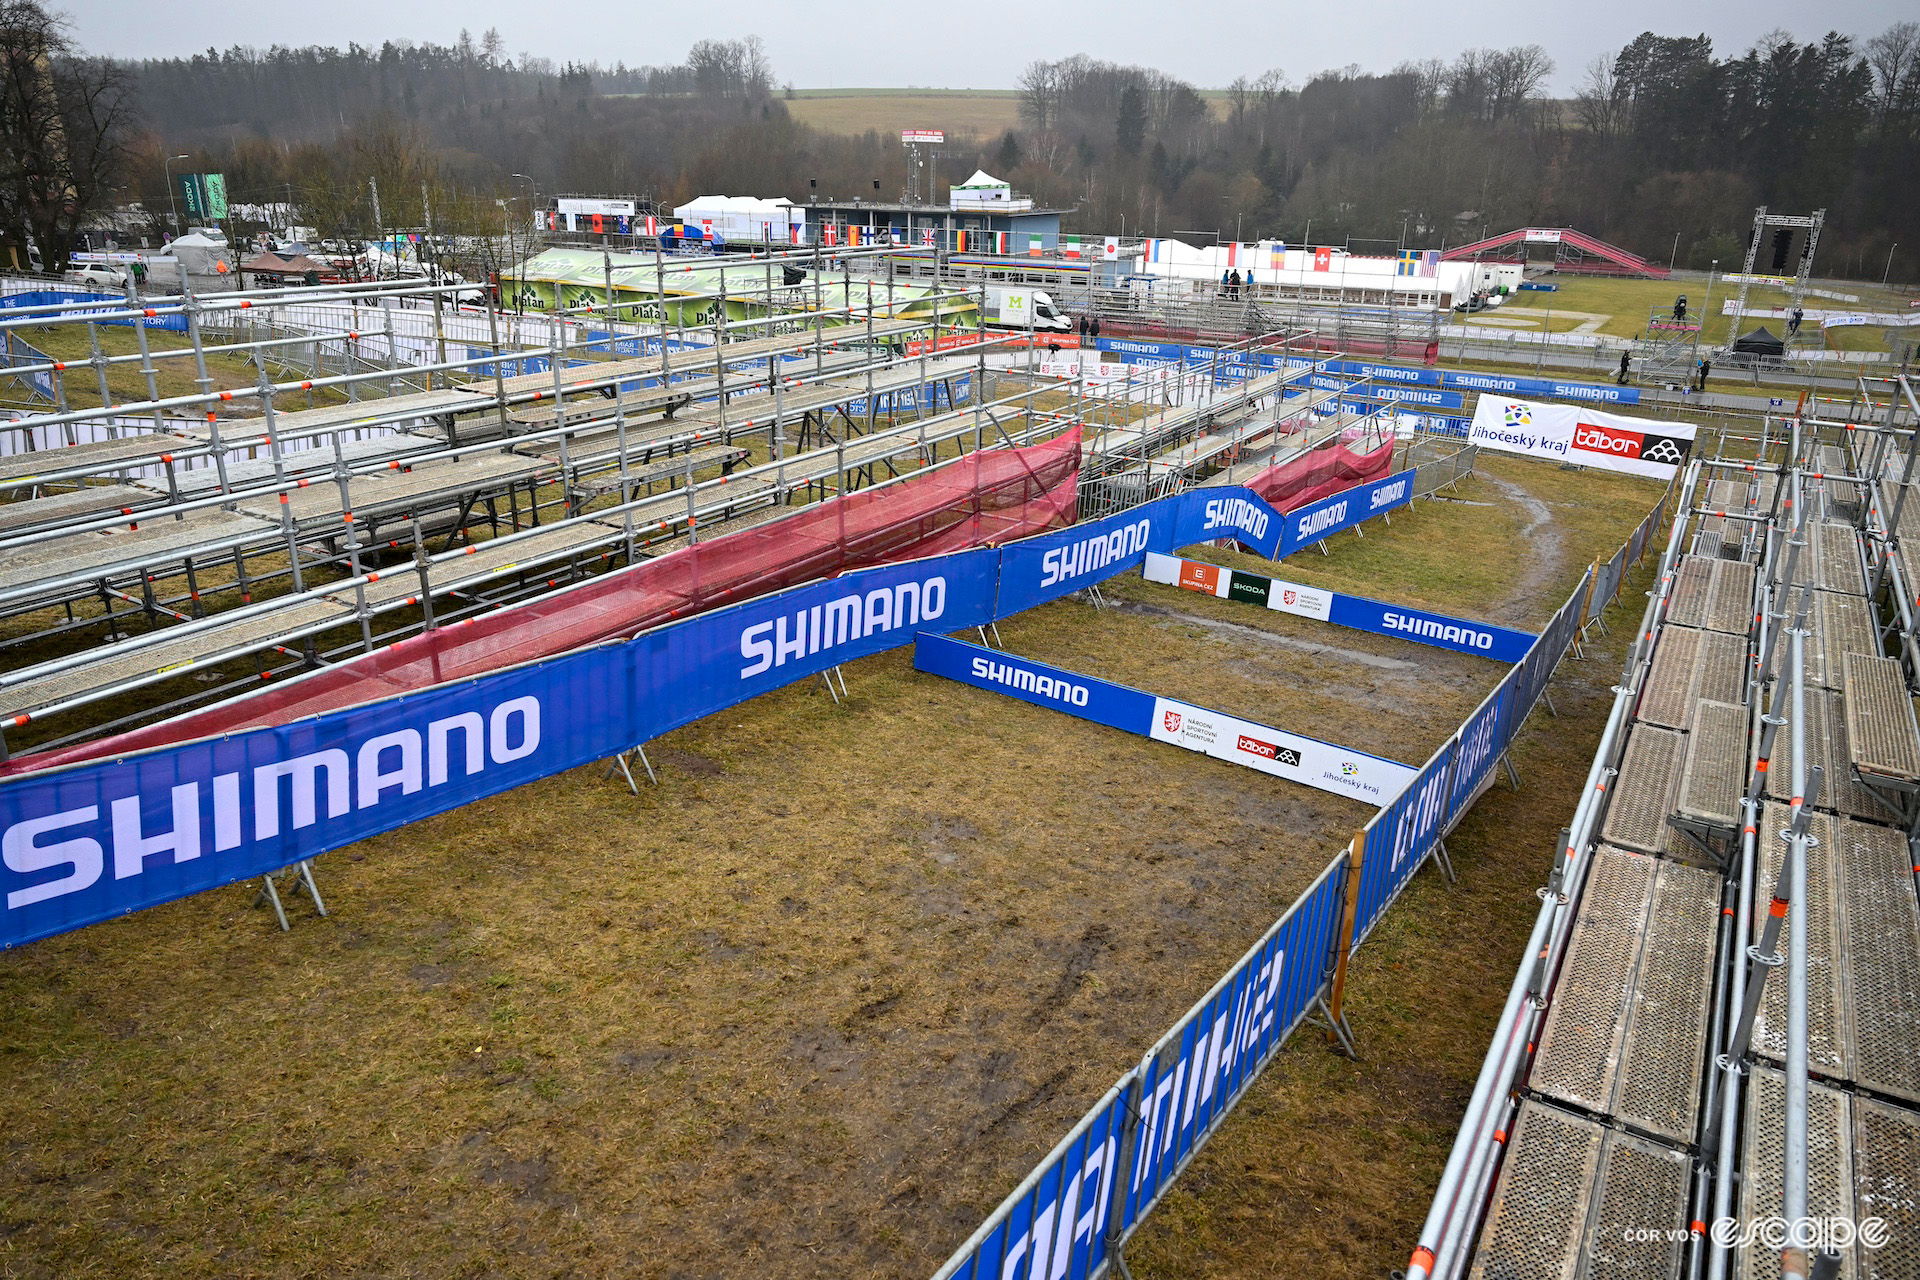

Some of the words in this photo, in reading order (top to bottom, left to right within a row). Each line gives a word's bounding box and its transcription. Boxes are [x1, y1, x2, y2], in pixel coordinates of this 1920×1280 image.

[1110, 341, 1159, 354] SHIMANO
[1362, 366, 1419, 381] SHIMANO
[1456, 376, 1517, 391] SHIMANO
[1555, 385, 1619, 400] SHIMANO
[1472, 425, 1536, 450] Jihočeský
[1541, 437, 1569, 455] kraj
[1370, 479, 1405, 510] SHIMANO
[1204, 498, 1269, 541] SHIMANO
[1296, 500, 1348, 542] SHIMANO
[1041, 519, 1150, 588] SHIMANO
[1182, 579, 1204, 588] SKUPINA
[740, 576, 946, 681] SHIMANO
[1382, 612, 1494, 650] SHIMANO
[972, 657, 1089, 707] SHIMANO
[1185, 731, 1215, 744] AGENTURA
[1186, 725, 1218, 738] SPORTOVNÍ
[1187, 718, 1213, 730] NÁRODNÍ
[1323, 771, 1362, 790] Jihočeský
[1363, 782, 1380, 795] kraj
[4, 696, 541, 908] SHIMANO
